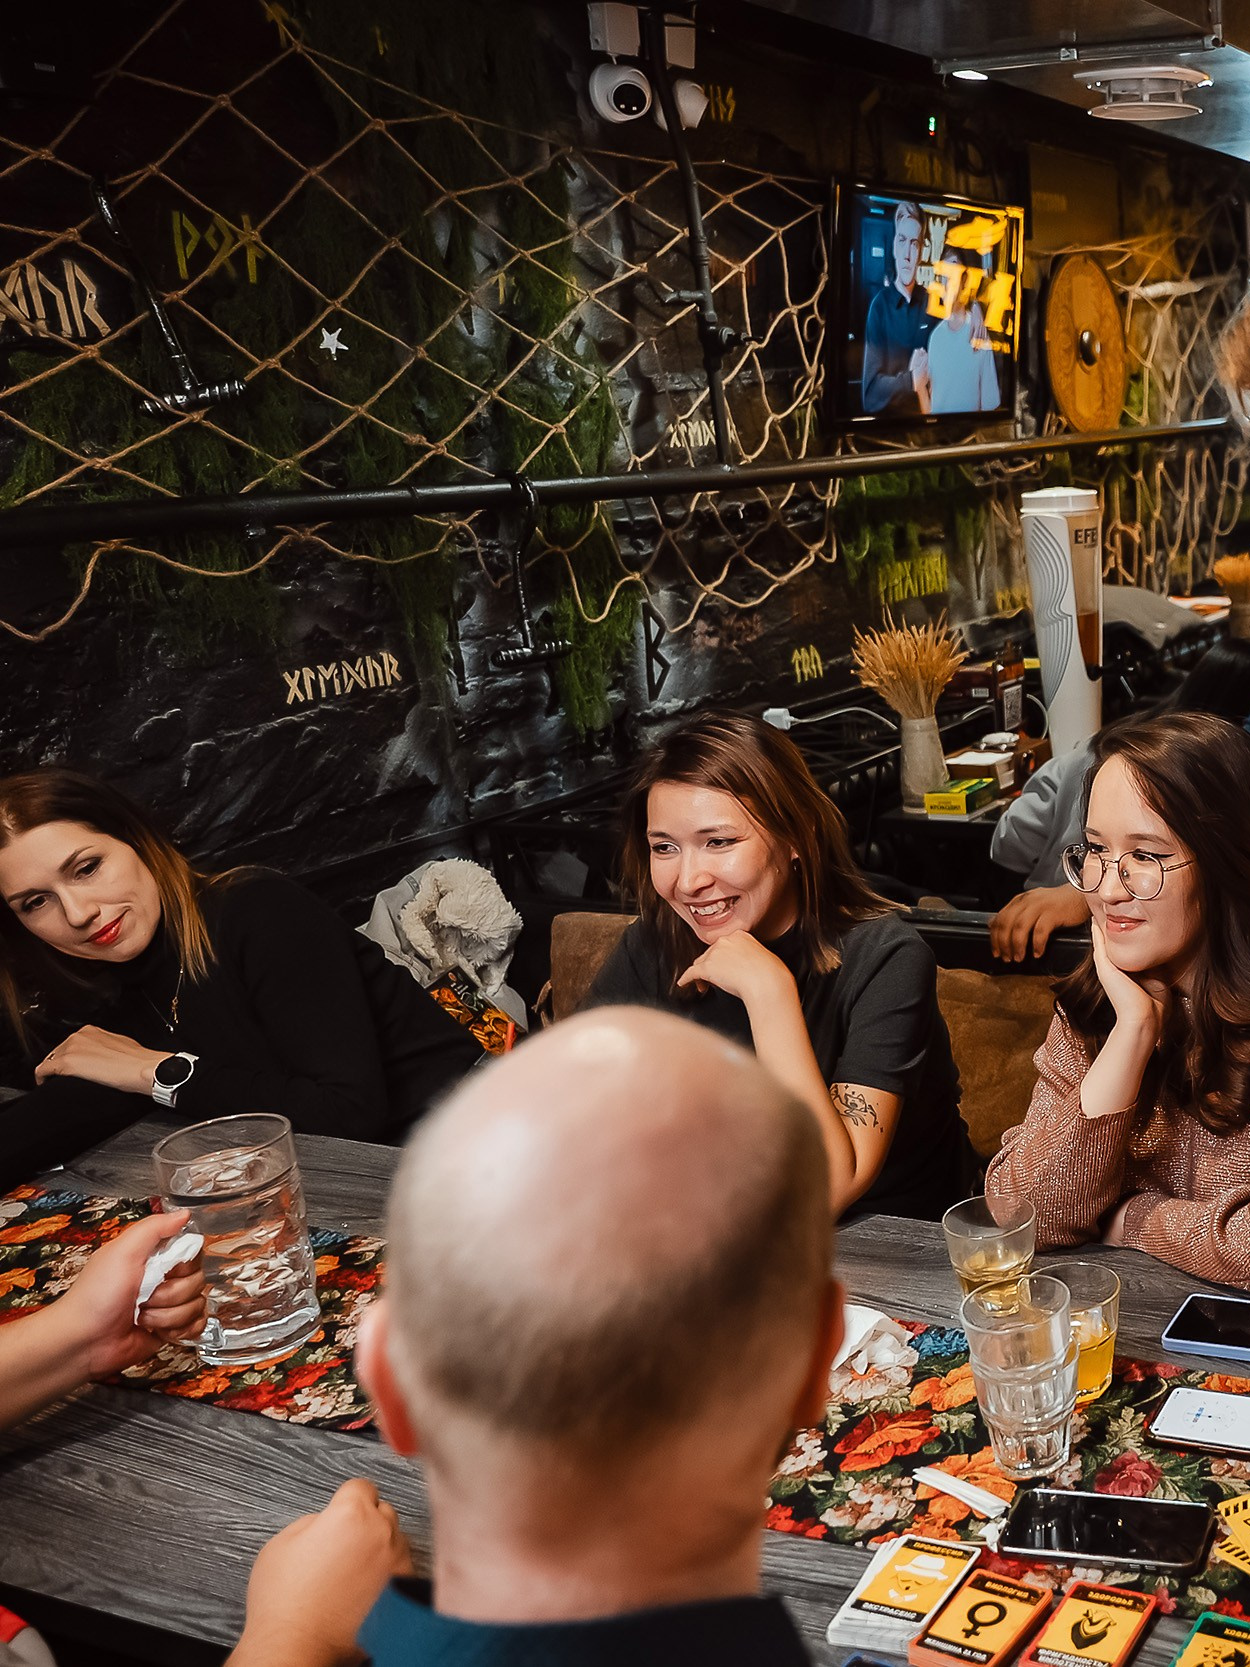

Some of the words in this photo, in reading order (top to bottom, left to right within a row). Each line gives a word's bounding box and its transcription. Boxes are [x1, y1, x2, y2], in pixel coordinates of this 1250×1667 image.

[913, 1541, 964, 1557] ПРОФЕССИЯ
[984, 1581, 1030, 1599] БИОЛОГИЯ
[1087, 1591, 1135, 1606] ЗДОРОВЬЕ
[861, 1602, 918, 1620] ЭКСТРАСЕНС
[923, 1637, 963, 1655] ЖЕНЩИНА
